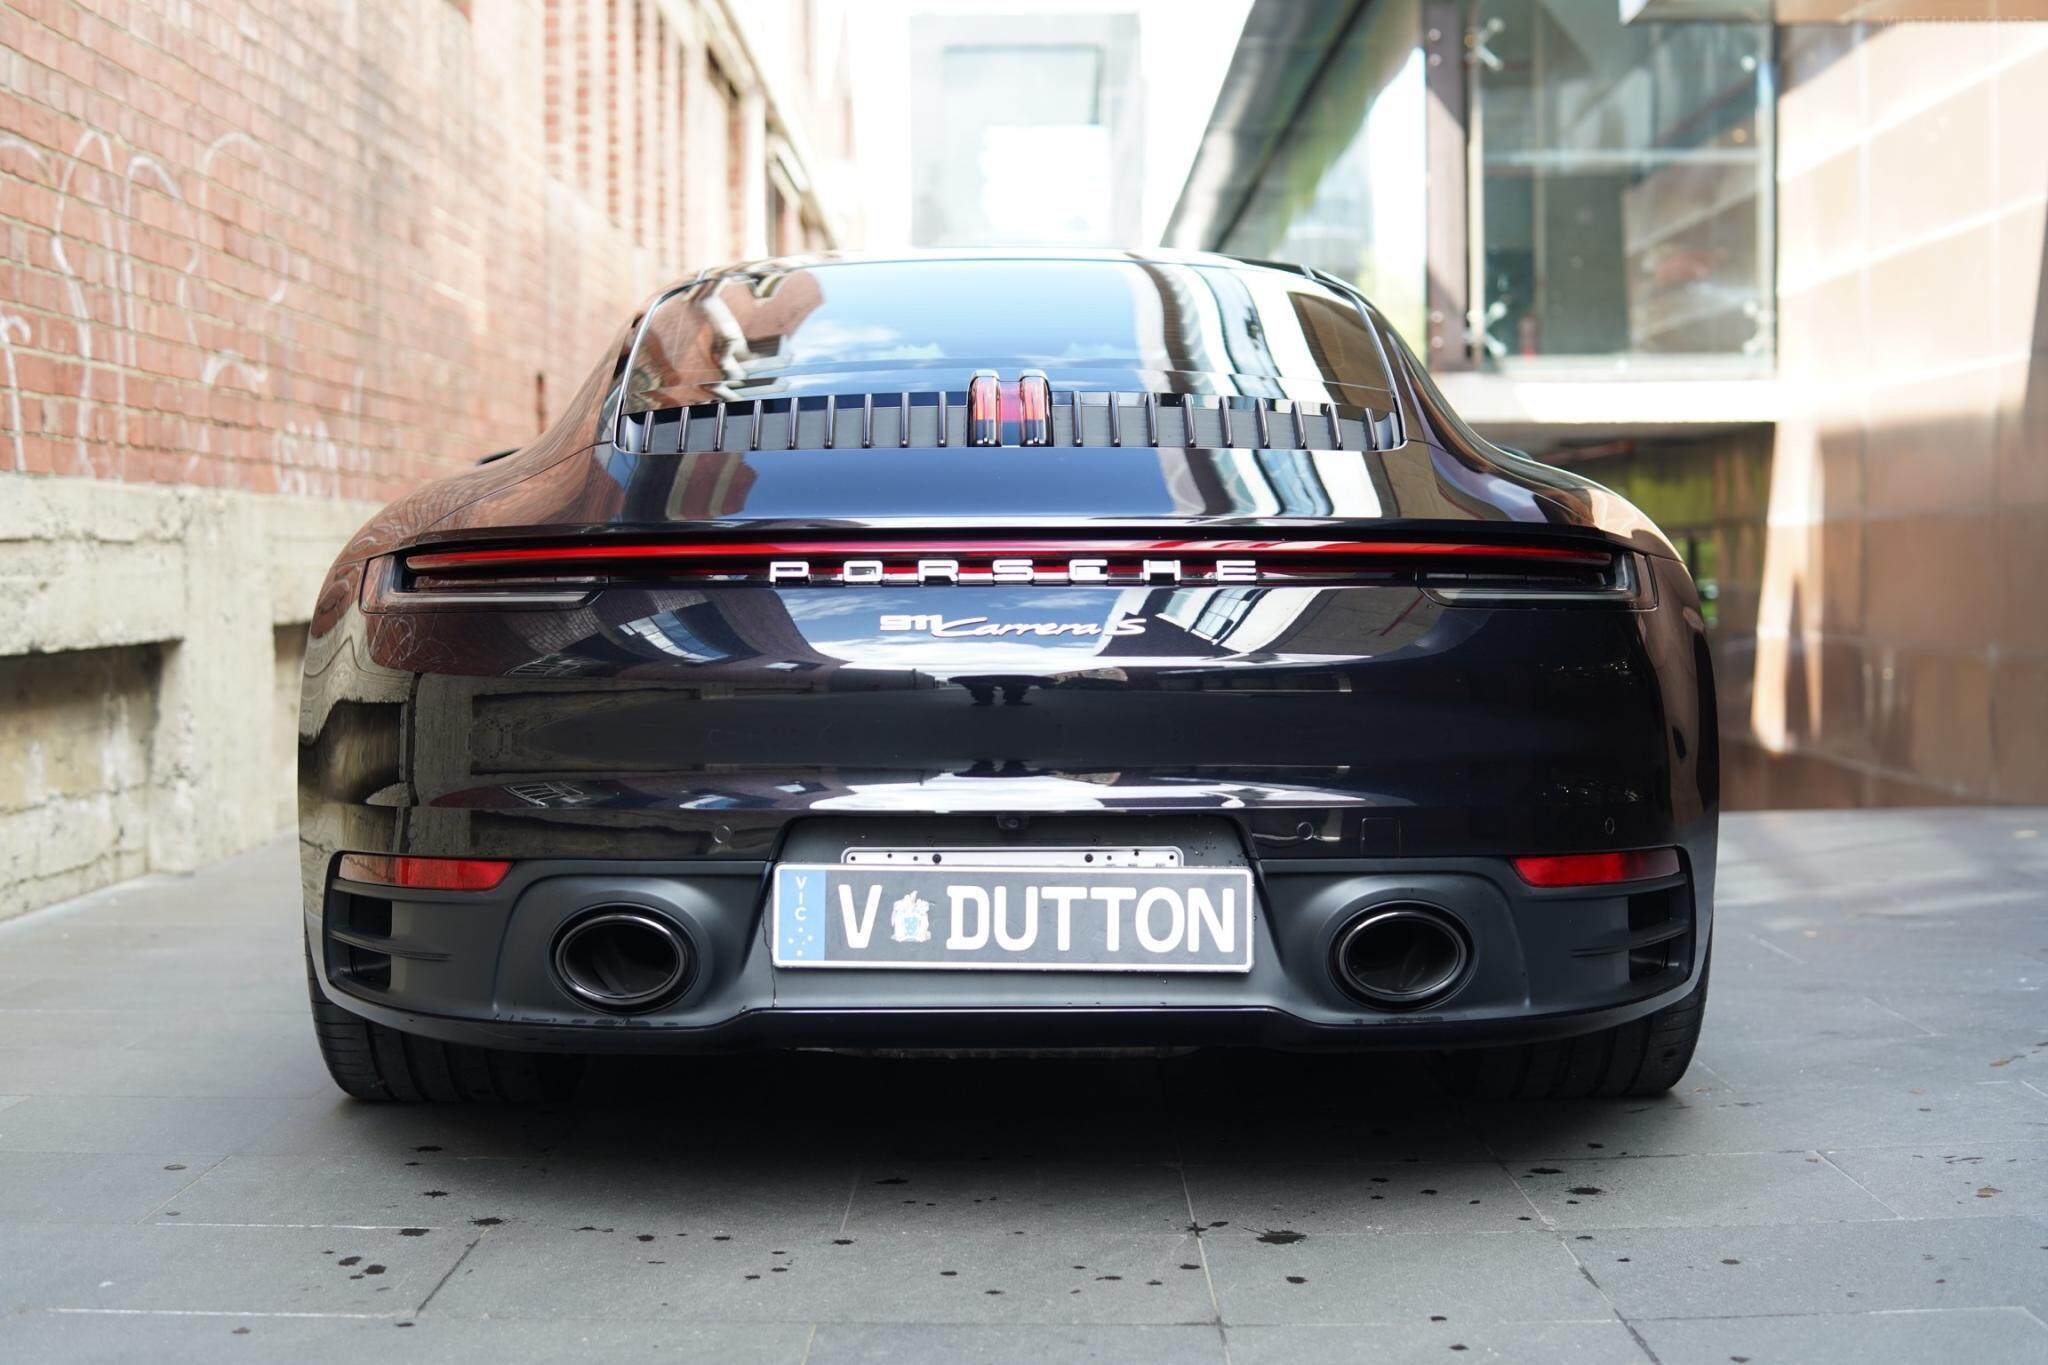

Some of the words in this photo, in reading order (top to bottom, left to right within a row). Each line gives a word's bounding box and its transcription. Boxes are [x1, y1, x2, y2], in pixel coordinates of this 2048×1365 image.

[769, 559, 1257, 583] PORSCHE
[880, 614, 942, 631] 911
[931, 616, 1101, 637] Carrera
[1103, 618, 1147, 636] S
[794, 876, 808, 921] VIC
[838, 884, 883, 949] V
[946, 885, 1235, 953] DUTTON
